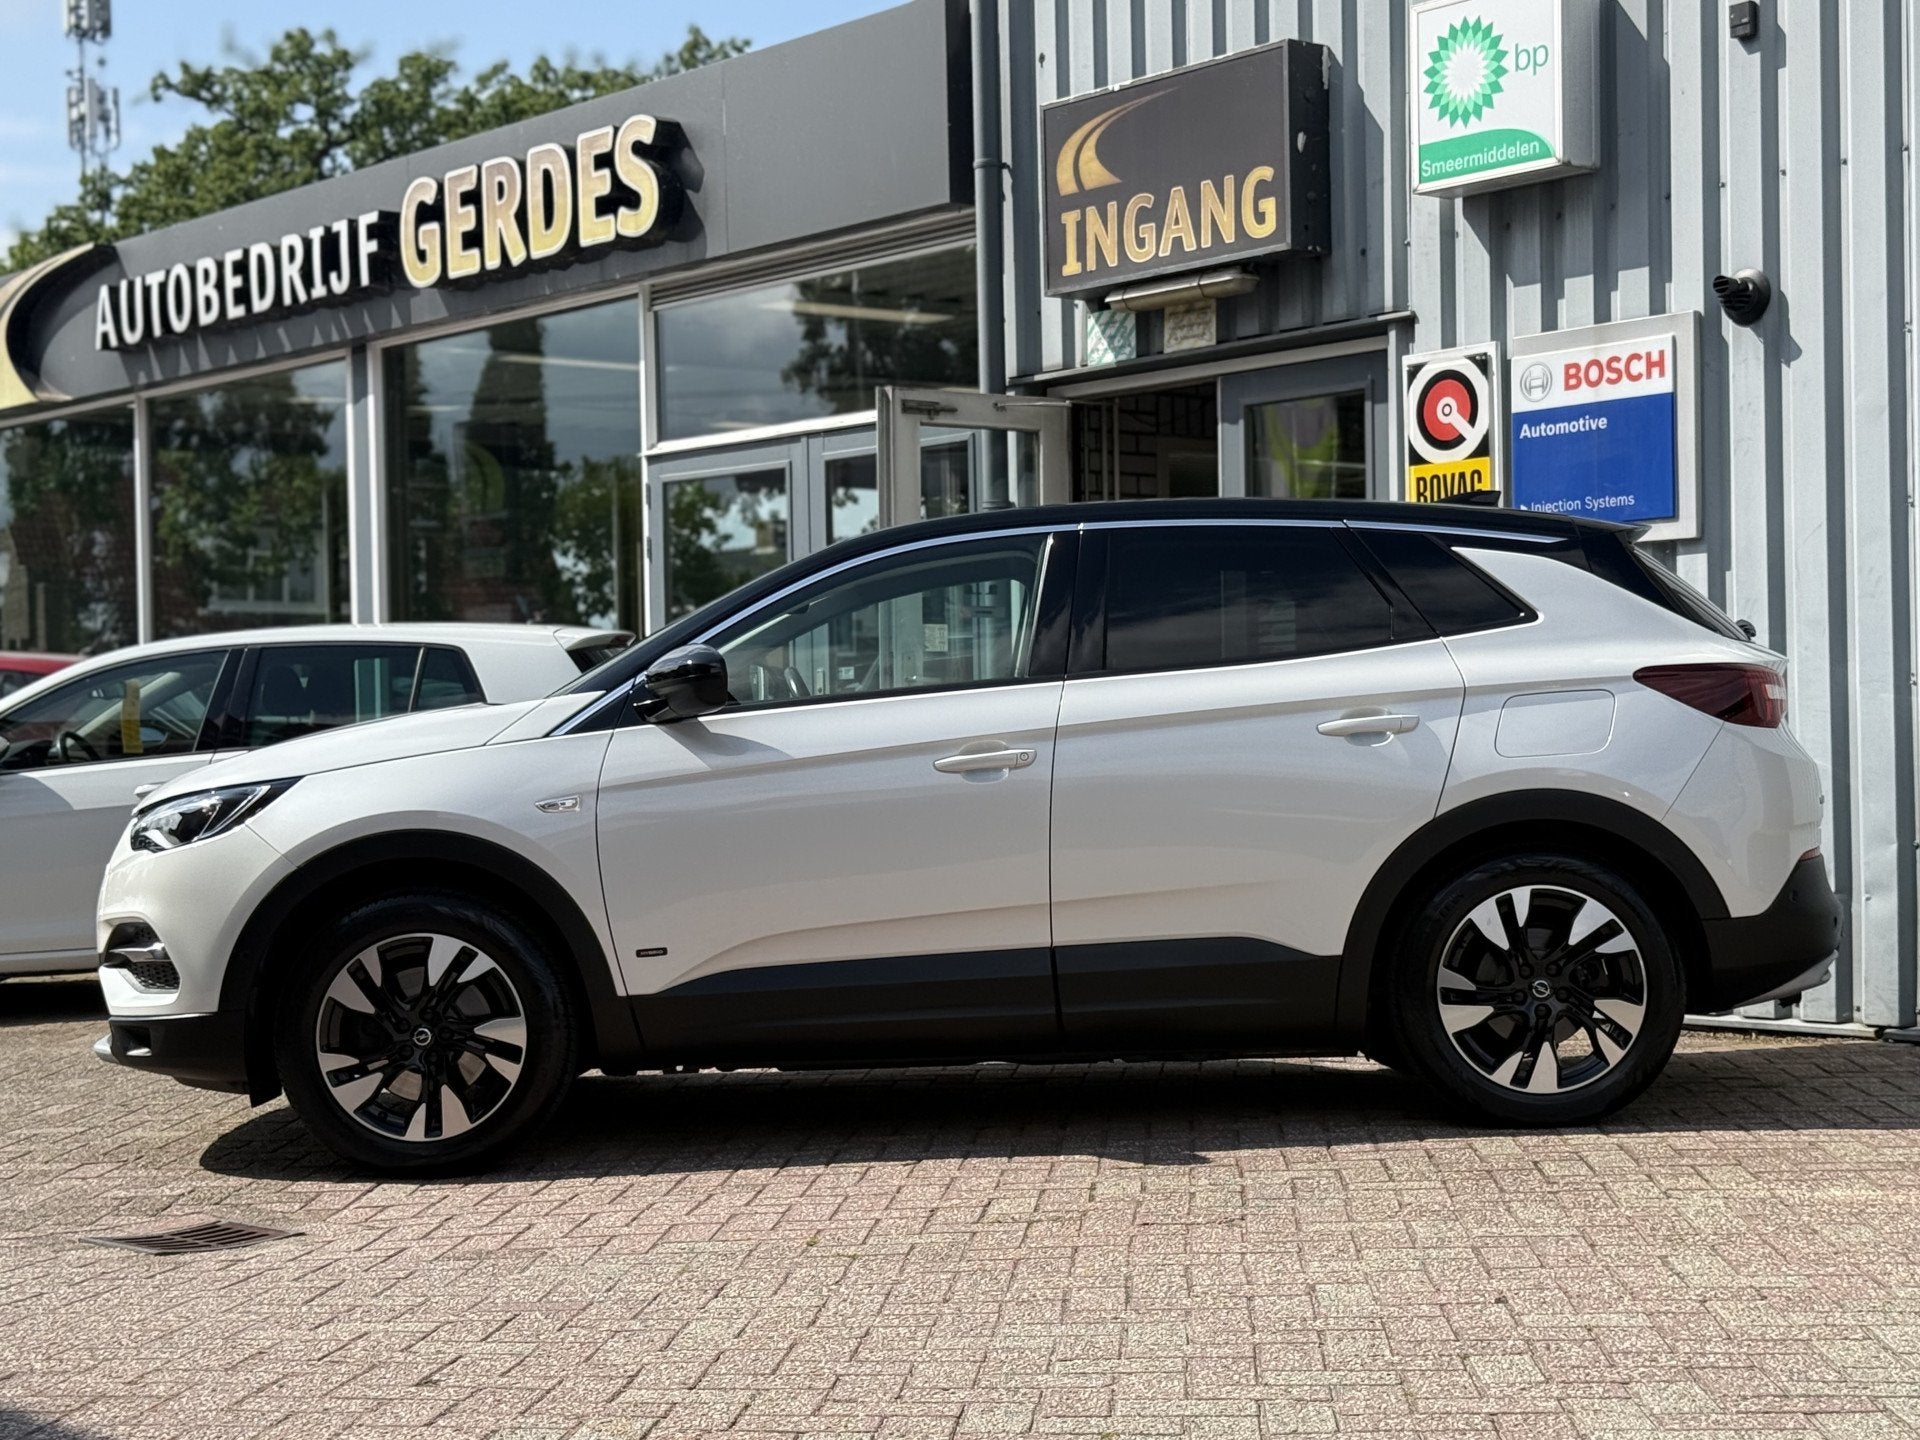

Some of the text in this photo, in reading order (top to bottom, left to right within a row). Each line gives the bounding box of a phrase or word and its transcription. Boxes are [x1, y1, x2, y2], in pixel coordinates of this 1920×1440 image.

[1514, 43, 1549, 76] bp
[1421, 141, 1540, 177] Smeermiddelen
[95, 114, 657, 350] AUTOBEDRIJF GERDES
[1061, 165, 1277, 277] INGANG
[1563, 349, 1666, 391] BOSCH
[1519, 415, 1608, 439] Automotive
[1531, 494, 1635, 513] Injection Systems
